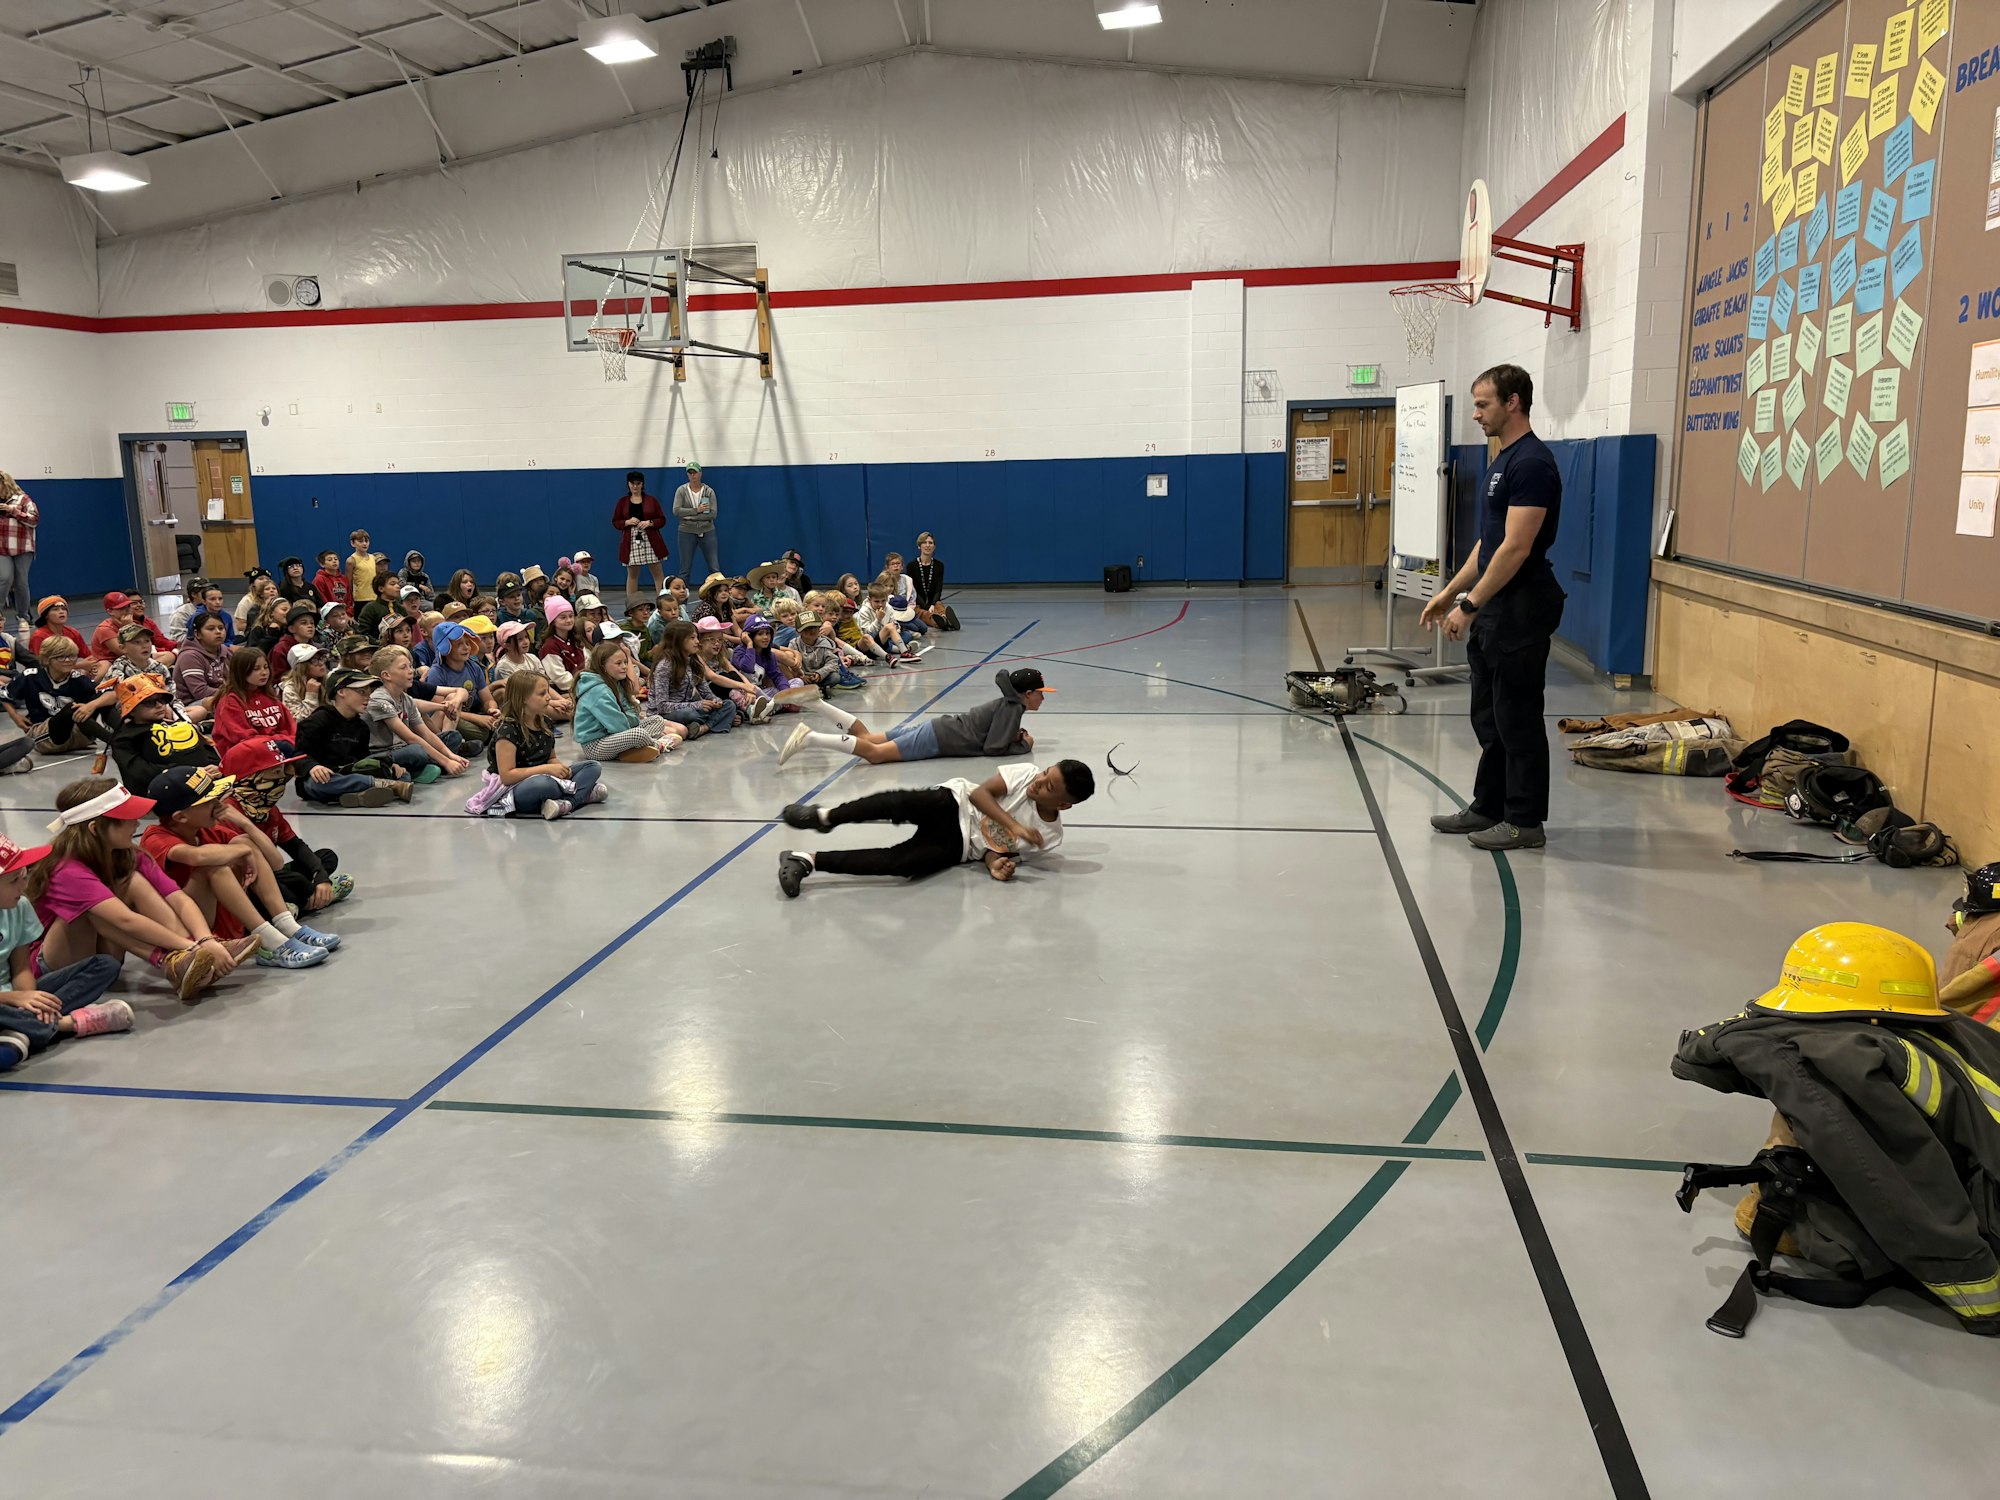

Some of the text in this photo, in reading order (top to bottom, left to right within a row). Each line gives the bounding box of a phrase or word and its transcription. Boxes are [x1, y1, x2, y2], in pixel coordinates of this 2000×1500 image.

[1706, 222, 1712, 240] K
[1743, 202, 1749, 222] 2
[1697, 257, 1749, 296] JUNGLE JACKS
[1694, 301, 1721, 327] GIRAFFE
[1723, 293, 1748, 318] REACH
[1958, 295, 1969, 323] 2
[1692, 333, 1744, 364] FROG SQUATS
[1689, 372, 1743, 397] ELEPHANT TWIST
[1686, 411, 1740, 432] BUTTERFLY WING
[1145, 443, 1156, 453] 29
[1271, 439, 1282, 449] 30
[1975, 433, 1991, 446] Hope
[676, 456, 686, 464] 26
[829, 452, 838, 461] 27
[985, 449, 996, 457] 28
[1968, 498, 1985, 512] Unity
